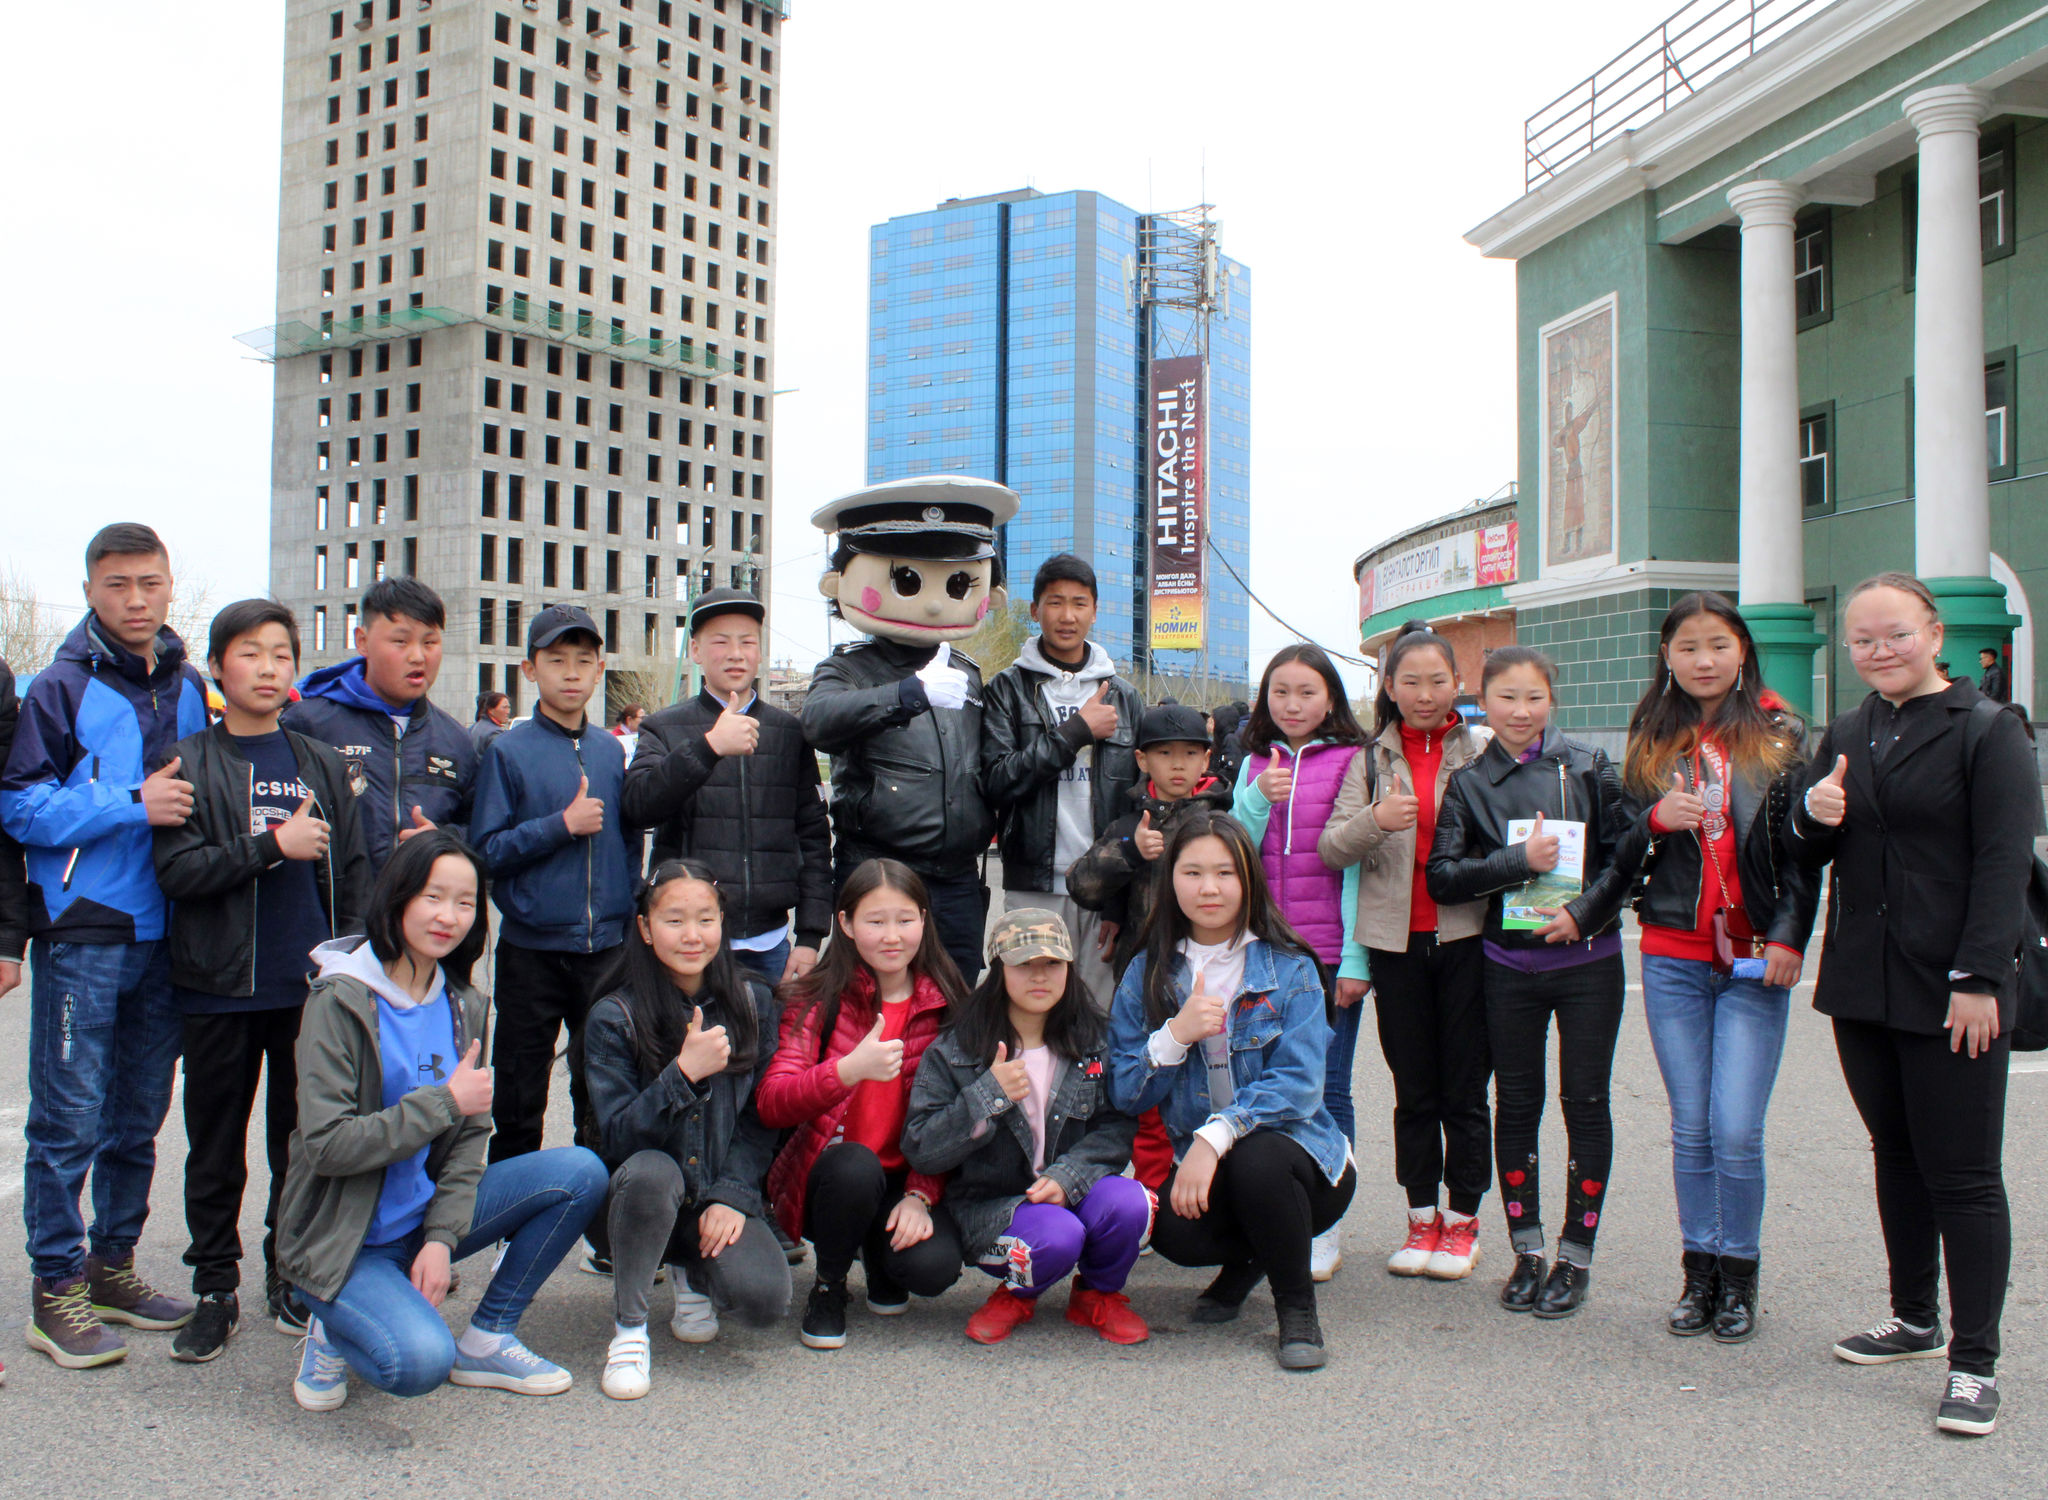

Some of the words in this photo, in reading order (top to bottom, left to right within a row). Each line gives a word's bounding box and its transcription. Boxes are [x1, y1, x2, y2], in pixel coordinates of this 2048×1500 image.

[1179, 379, 1196, 430] Next
[1157, 389, 1178, 546] HITACHI
[1181, 436, 1196, 472] the
[1181, 478, 1198, 555] Inspire
[1154, 622, 1198, 633] НОМИН
